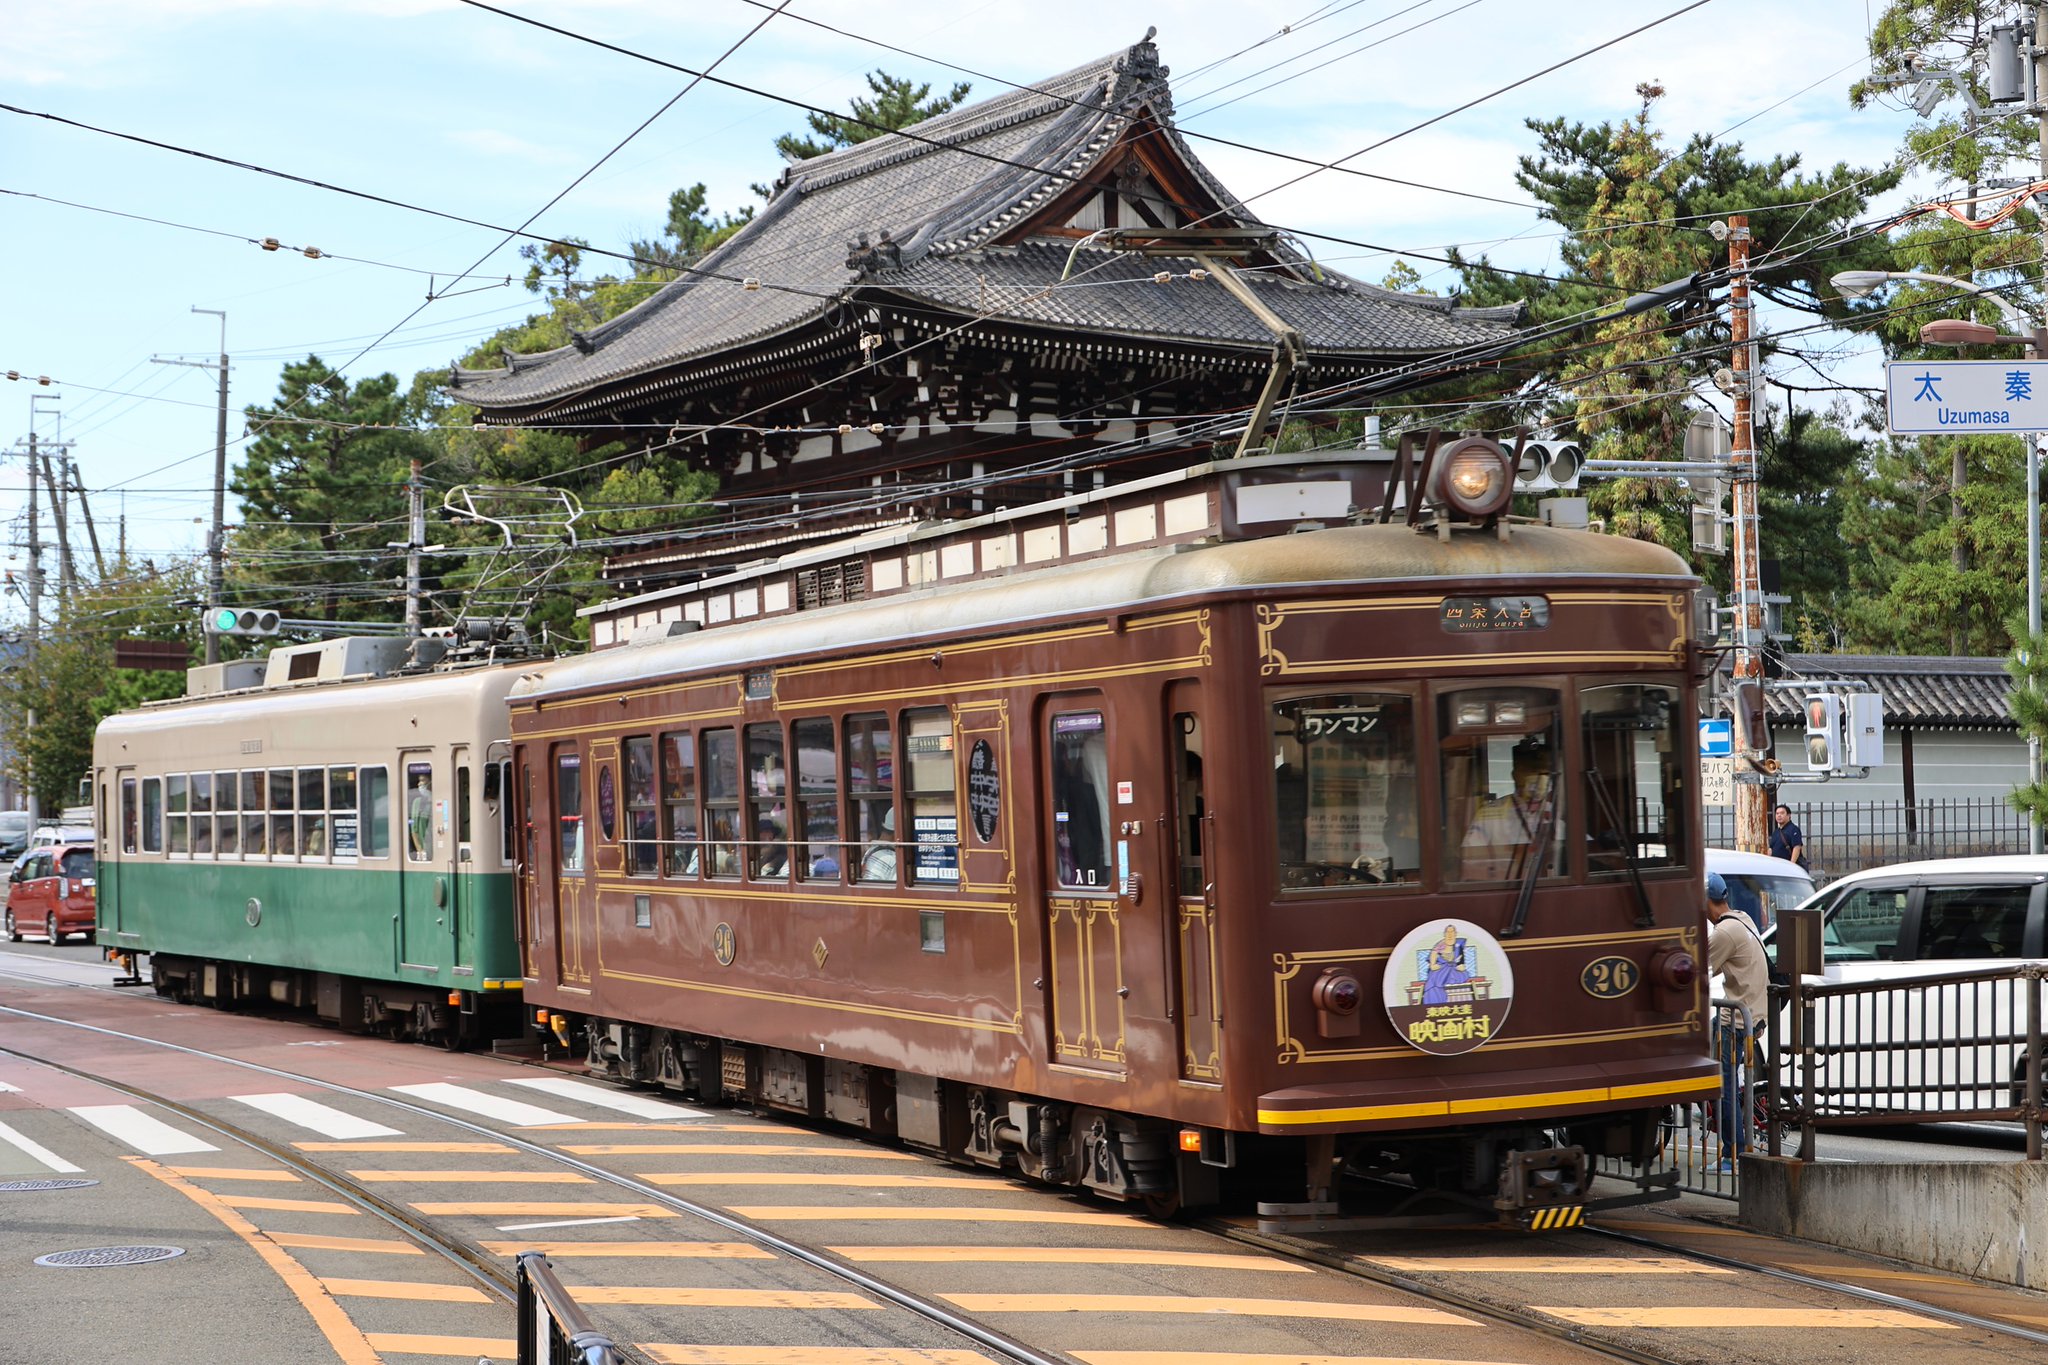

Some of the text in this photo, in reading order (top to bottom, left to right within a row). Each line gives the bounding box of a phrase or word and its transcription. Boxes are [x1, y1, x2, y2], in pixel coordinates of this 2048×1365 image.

[1914, 370, 2032, 401] 太秦
[1938, 408, 2009, 425] Uzumasa
[1305, 716, 1378, 735] ワンマン
[1701, 762, 1731, 774] 型バス
[1704, 790, 1724, 801] -21
[1075, 868, 1097, 885] 入口
[715, 928, 732, 960] 26
[1592, 961, 1630, 992] 26
[1408, 1014, 1491, 1043] 映画村
